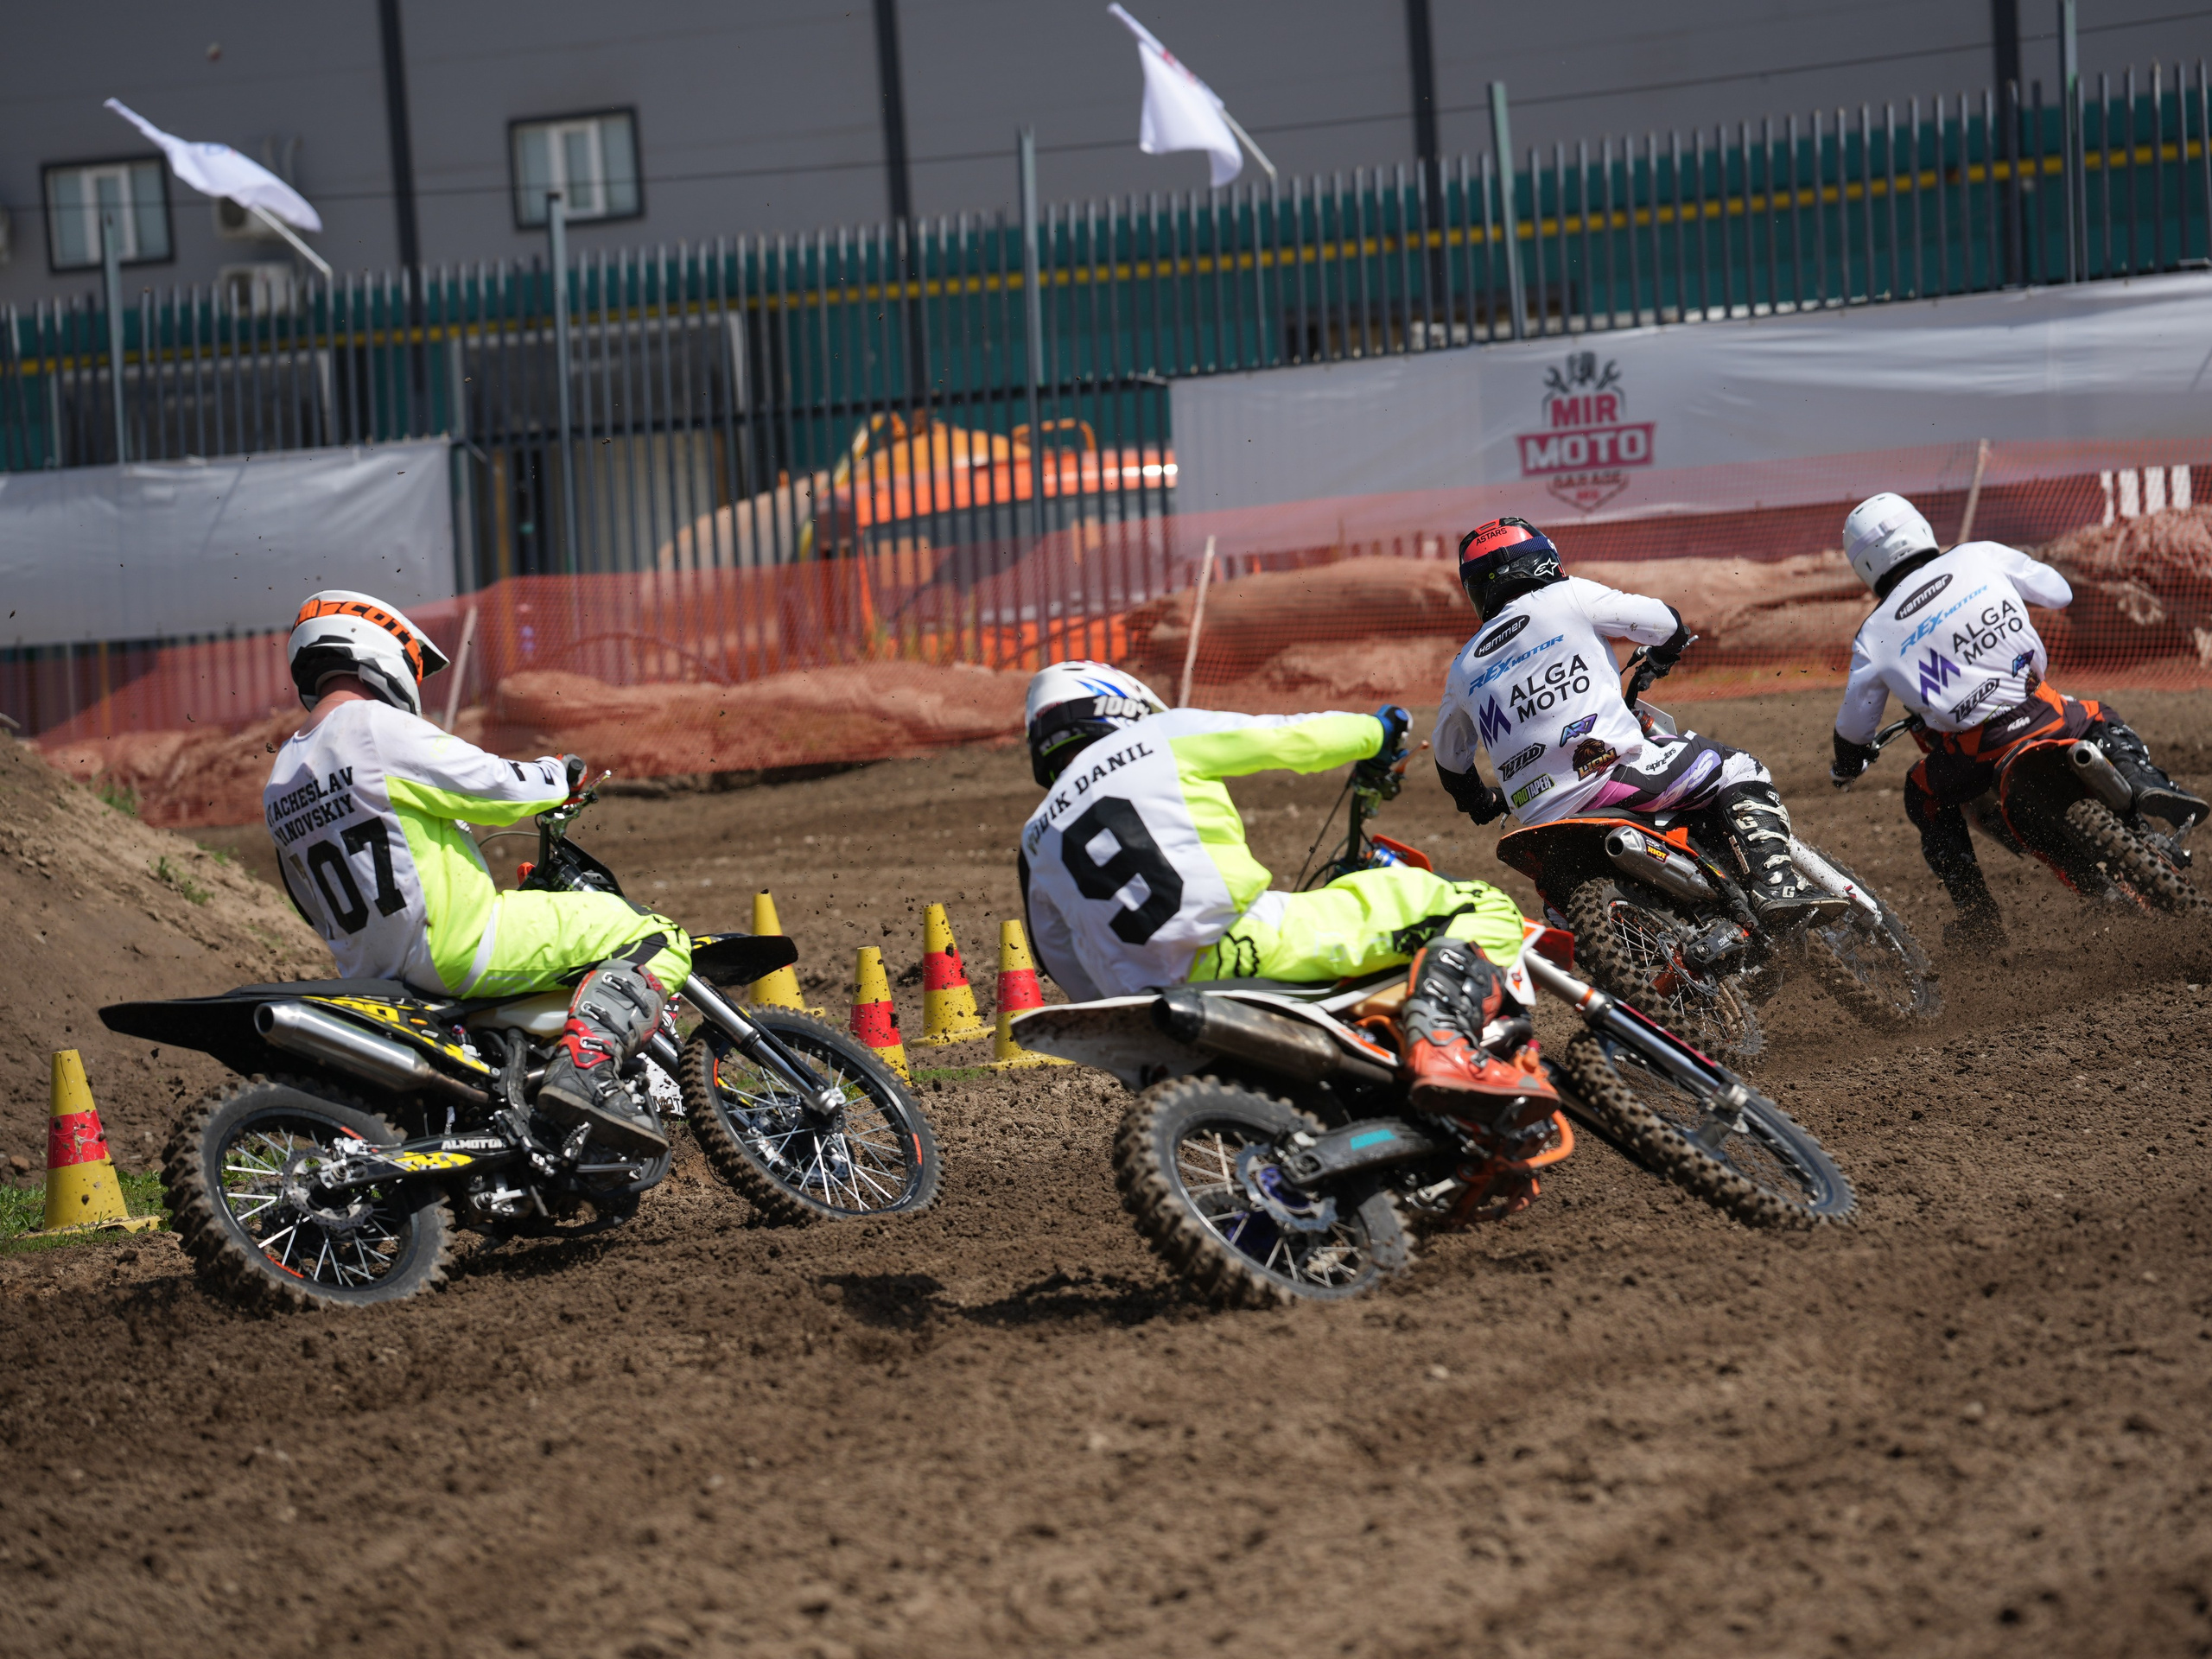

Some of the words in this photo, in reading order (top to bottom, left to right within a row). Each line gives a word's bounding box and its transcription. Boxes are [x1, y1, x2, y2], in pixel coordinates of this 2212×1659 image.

[1551, 394, 1618, 428] MIR
[1525, 429, 1647, 471] MOTO
[1476, 527, 1508, 546] ASTARS
[1900, 574, 1948, 619] Hammer
[1478, 617, 1526, 656] Hammer
[1952, 599, 2018, 655] ALGA
[1962, 617, 2024, 665] MOTO
[1509, 653, 1589, 709] ALGA
[1516, 675, 1590, 723] MOTO
[1092, 694, 1151, 721] 100%
[2006, 715, 2031, 732] KTM
[1074, 742, 1154, 795] DANIL
[1578, 747, 1617, 779] LION
[1061, 795, 1184, 946] 9
[1647, 846, 1667, 860] RIOT
[1782, 886, 1796, 898] G
